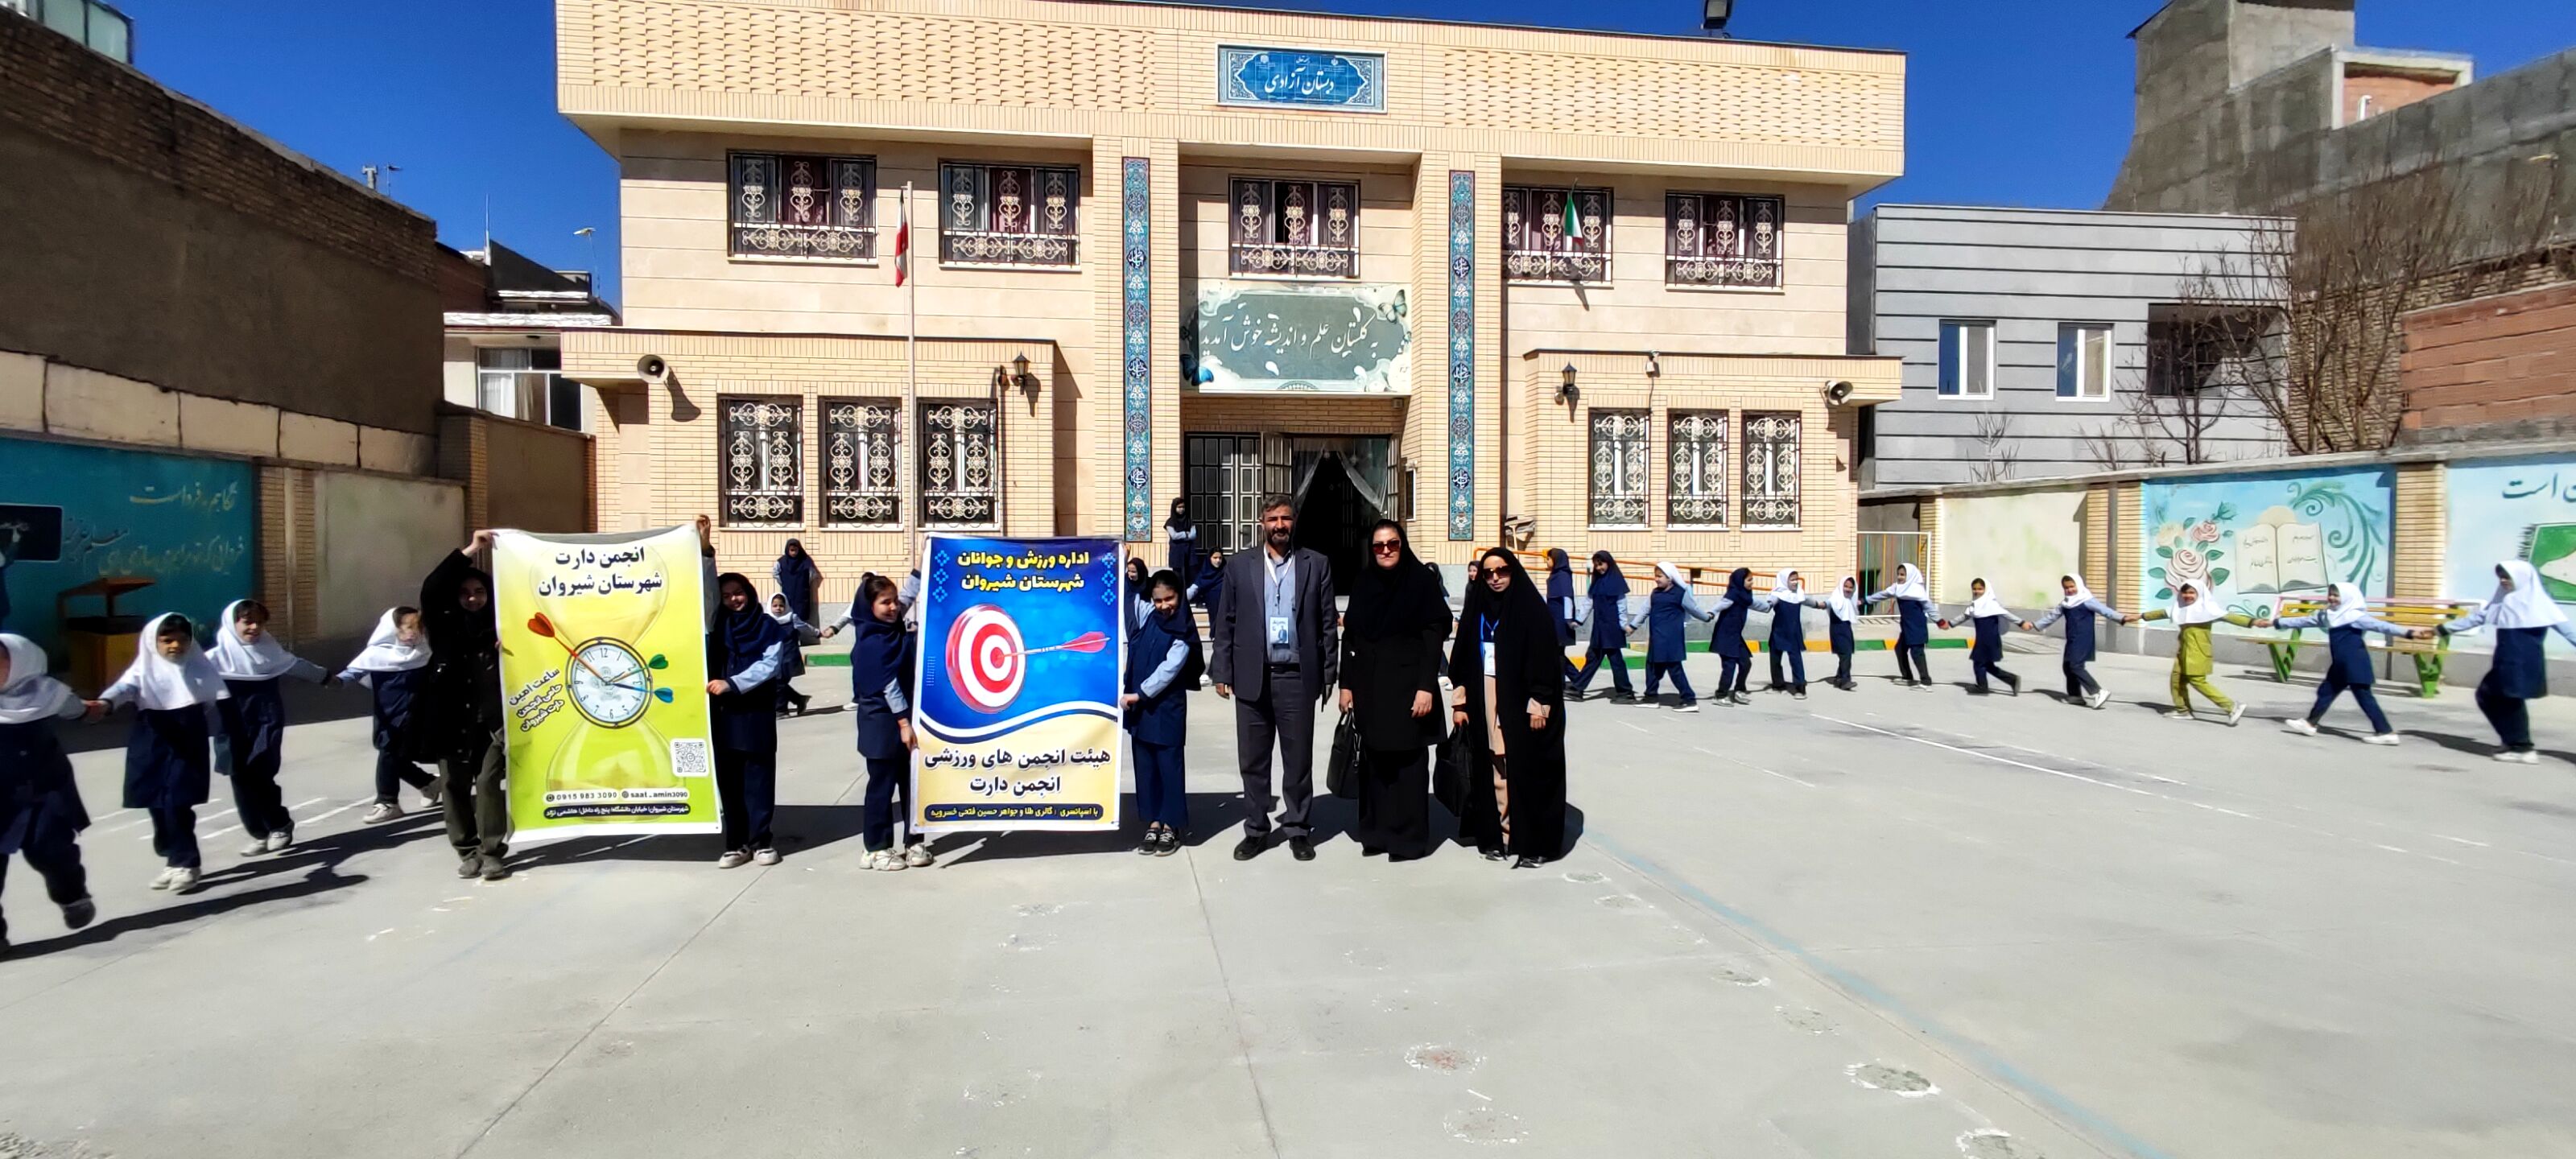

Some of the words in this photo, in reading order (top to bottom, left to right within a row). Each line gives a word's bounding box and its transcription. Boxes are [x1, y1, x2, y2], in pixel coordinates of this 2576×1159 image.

[1264, 66, 1307, 93] آزادی
[1301, 70, 1334, 95] دبستان
[1201, 315, 1234, 356] آمدید
[1231, 315, 1262, 351] خوش
[1264, 322, 1297, 354] اندیشه
[1301, 333, 1307, 345] و
[1309, 323, 1329, 359] علم
[1369, 340, 1379, 358] به
[2502, 472, 2558, 499] است
[555, 549, 595, 570] دارت
[600, 547, 645, 567] انجمن
[957, 551, 1004, 569] جوانان
[1006, 556, 1013, 567] و
[1017, 551, 1055, 570] ورزش
[1058, 551, 1090, 569] اداره
[539, 575, 595, 596] شیروان
[598, 572, 663, 595] شهرستان
[961, 573, 1017, 592] شیروان
[1018, 573, 1085, 592] شهرستان
[600, 648, 608, 658] 12
[533, 668, 560, 688] ساعت
[509, 684, 533, 705] امین
[542, 683, 563, 703] حامی
[516, 695, 543, 718] انجمن
[547, 699, 565, 713] دارت
[520, 707, 548, 732] شیروان
[925, 748, 976, 768] ورزشی
[981, 749, 1013, 769] های
[1018, 749, 1066, 769] انجمن
[1071, 749, 1111, 768] هیئت
[970, 777, 1009, 796] دارت
[1013, 777, 1061, 797] انجمن
[631, 806, 647, 814] خیابان
[667, 805, 689, 813] شهرستان
[958, 806, 976, 817] فتحی
[977, 809, 997, 817] حسین
[998, 807, 1018, 817] جواهر
[1025, 807, 1034, 815] طلا
[1035, 806, 1053, 817] گالری
[1060, 807, 1092, 818] اسپانسری
[1093, 807, 1098, 817] با
